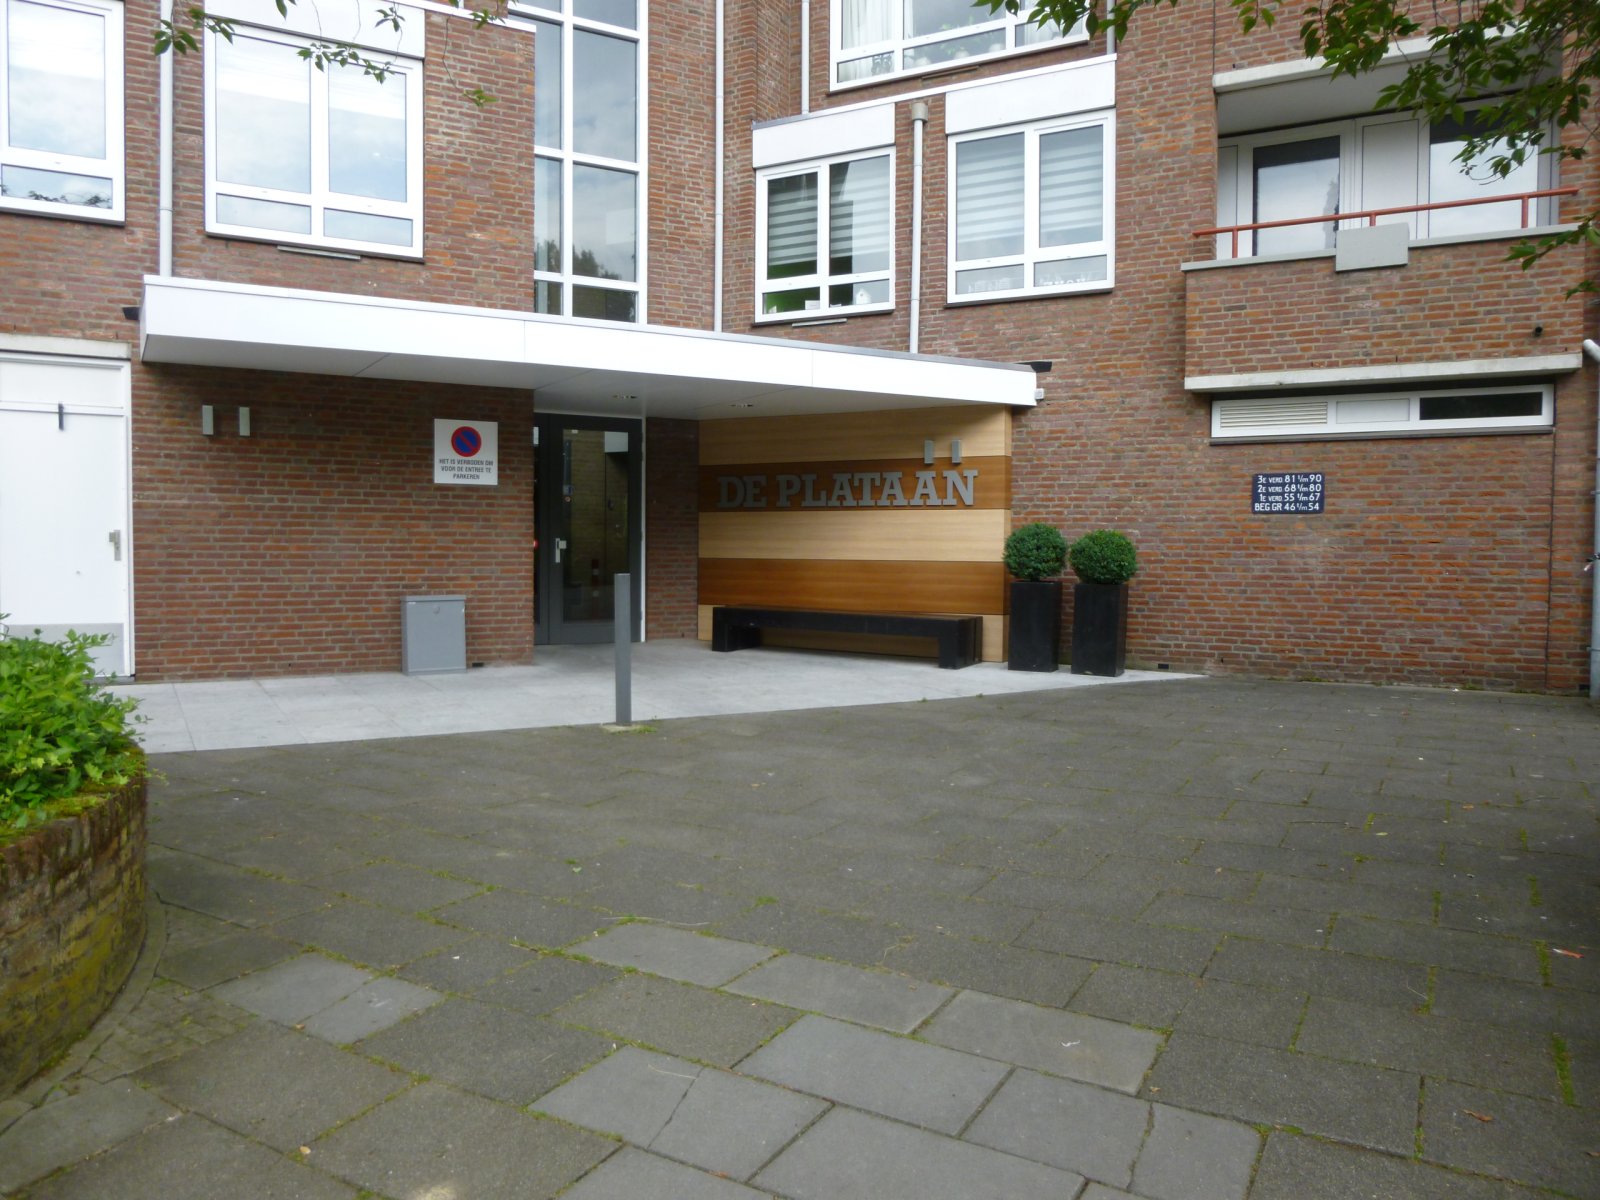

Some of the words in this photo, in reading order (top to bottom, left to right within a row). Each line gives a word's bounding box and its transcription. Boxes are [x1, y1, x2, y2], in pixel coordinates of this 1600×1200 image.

[1284, 474, 1295, 483] 81
[1309, 474, 1322, 483] 90
[717, 475, 767, 508] DE
[776, 470, 978, 507] PLATAAN
[1284, 484, 1296, 492] 68
[1309, 483, 1322, 492] 80
[1284, 493, 1295, 501] 55
[1309, 492, 1320, 501] 67
[1254, 503, 1270, 511] BEG
[1271, 503, 1282, 511] GR
[1284, 502, 1296, 511] 46
[1308, 502, 1319, 511] 54
